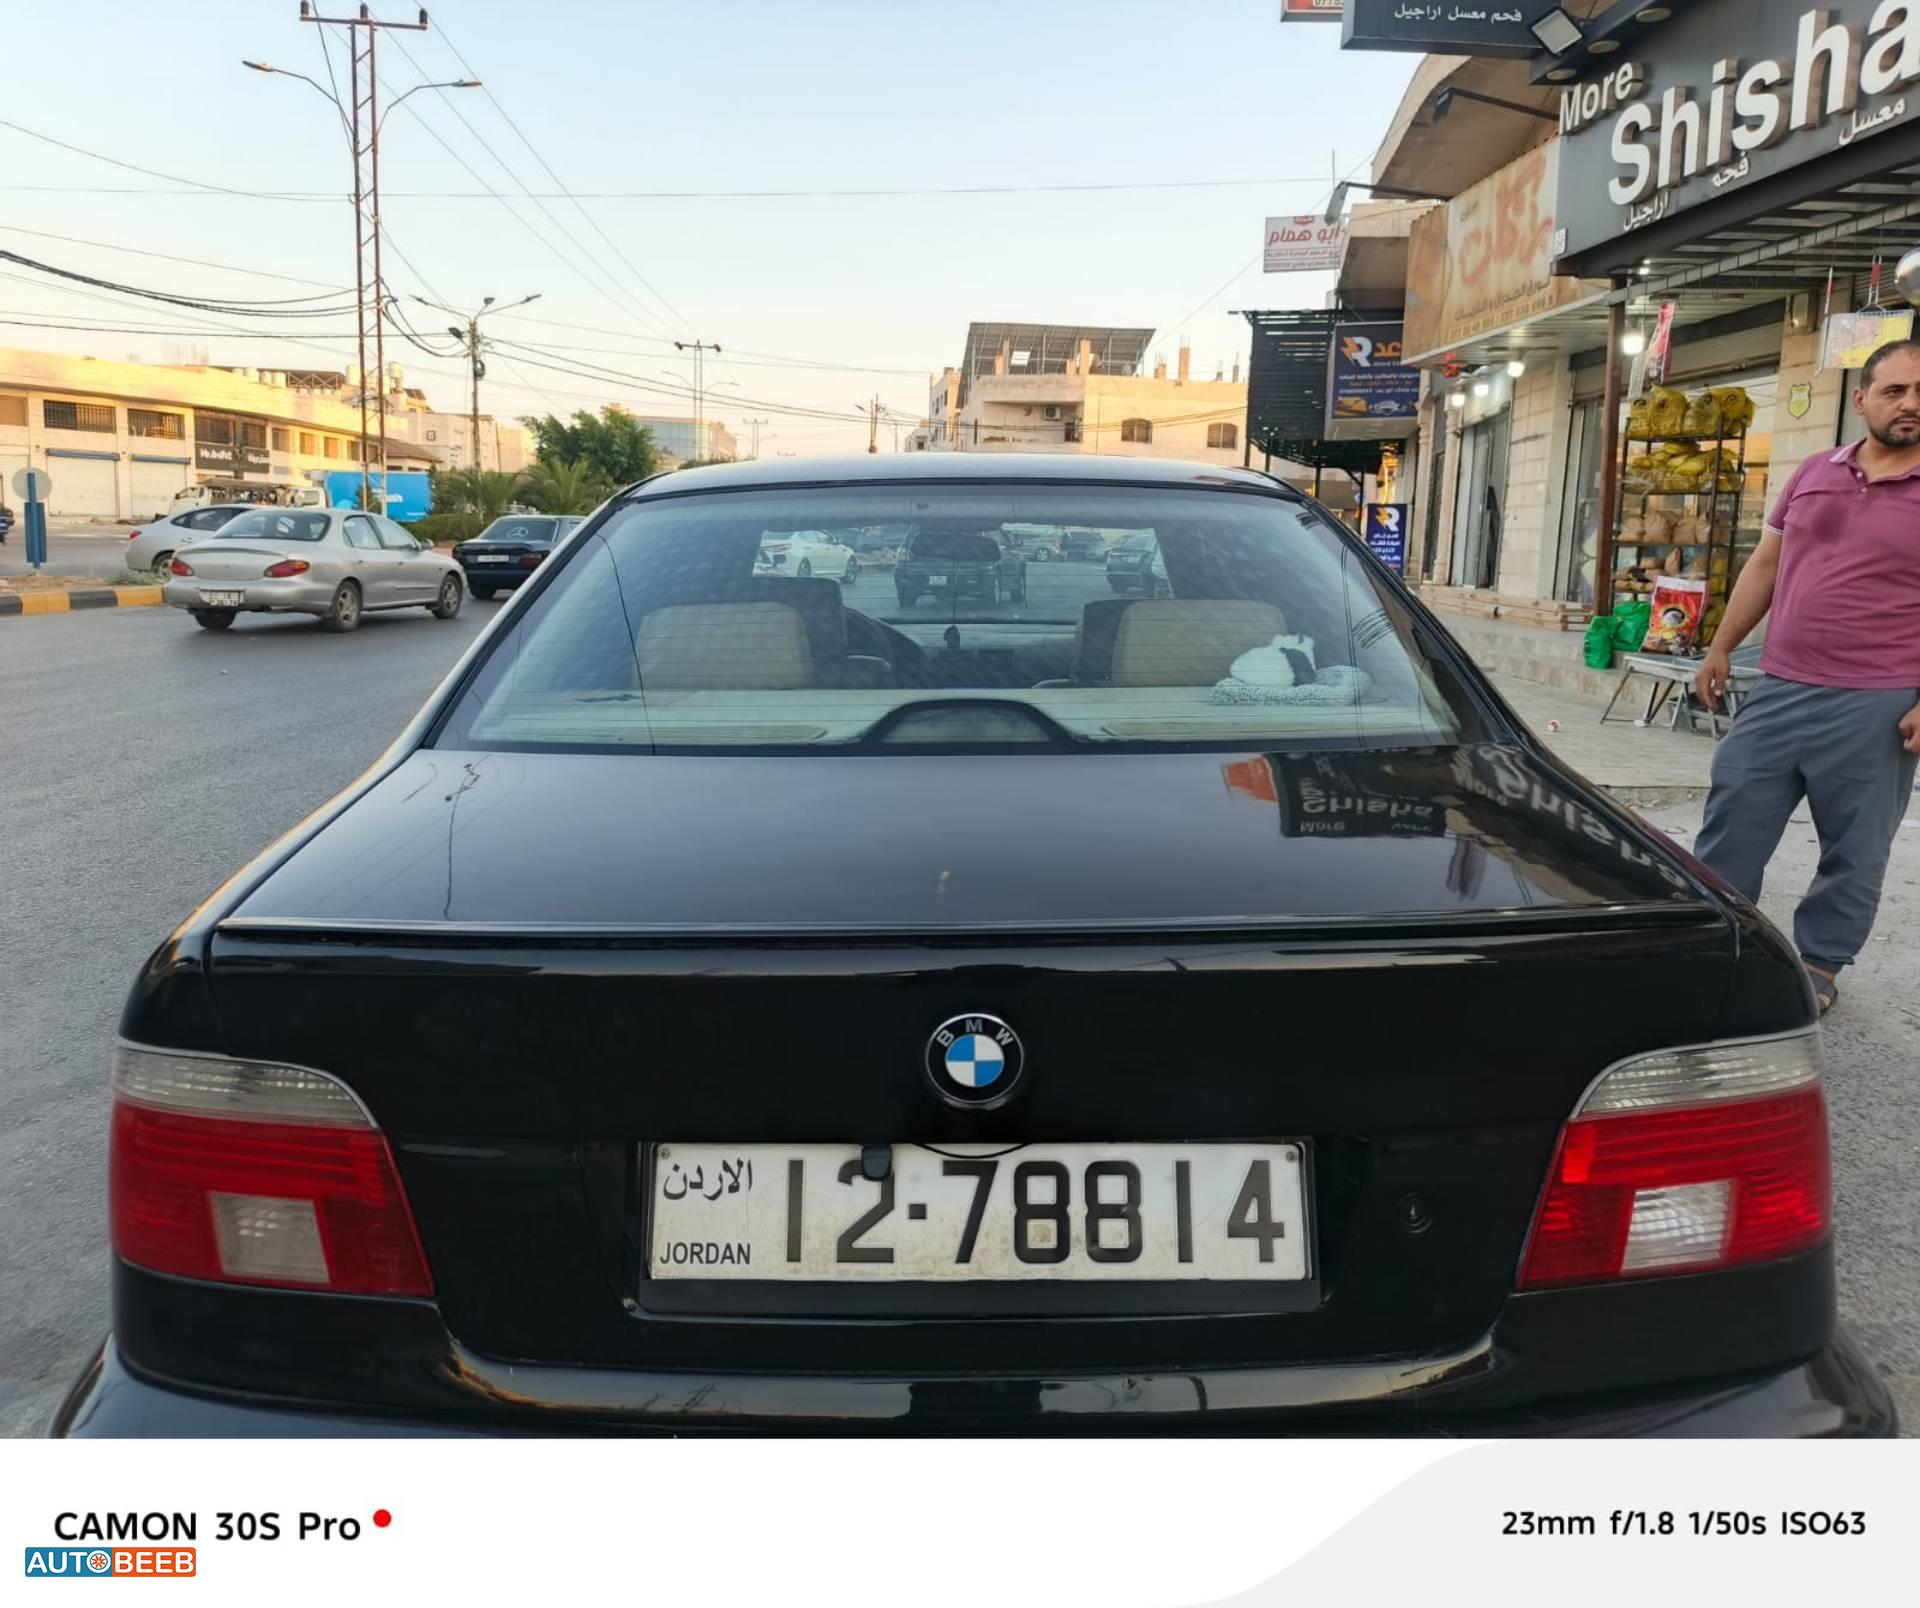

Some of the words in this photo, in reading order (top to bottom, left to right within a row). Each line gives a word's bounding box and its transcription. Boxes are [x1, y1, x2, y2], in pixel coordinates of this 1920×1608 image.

[1394, 3, 1441, 20] اراجيل
[1447, 6, 1487, 21] معسل
[1490, 8, 1523, 24] فحم
[1559, 61, 1641, 136] More
[1608, 0, 1920, 206] Shisha
[1838, 97, 1906, 146] معسل
[1267, 227, 1313, 247] همام
[936, 1019, 1014, 1047] BMW
[663, 1156, 753, 1201] الاردن
[660, 1242, 751, 1265] JORDAN
